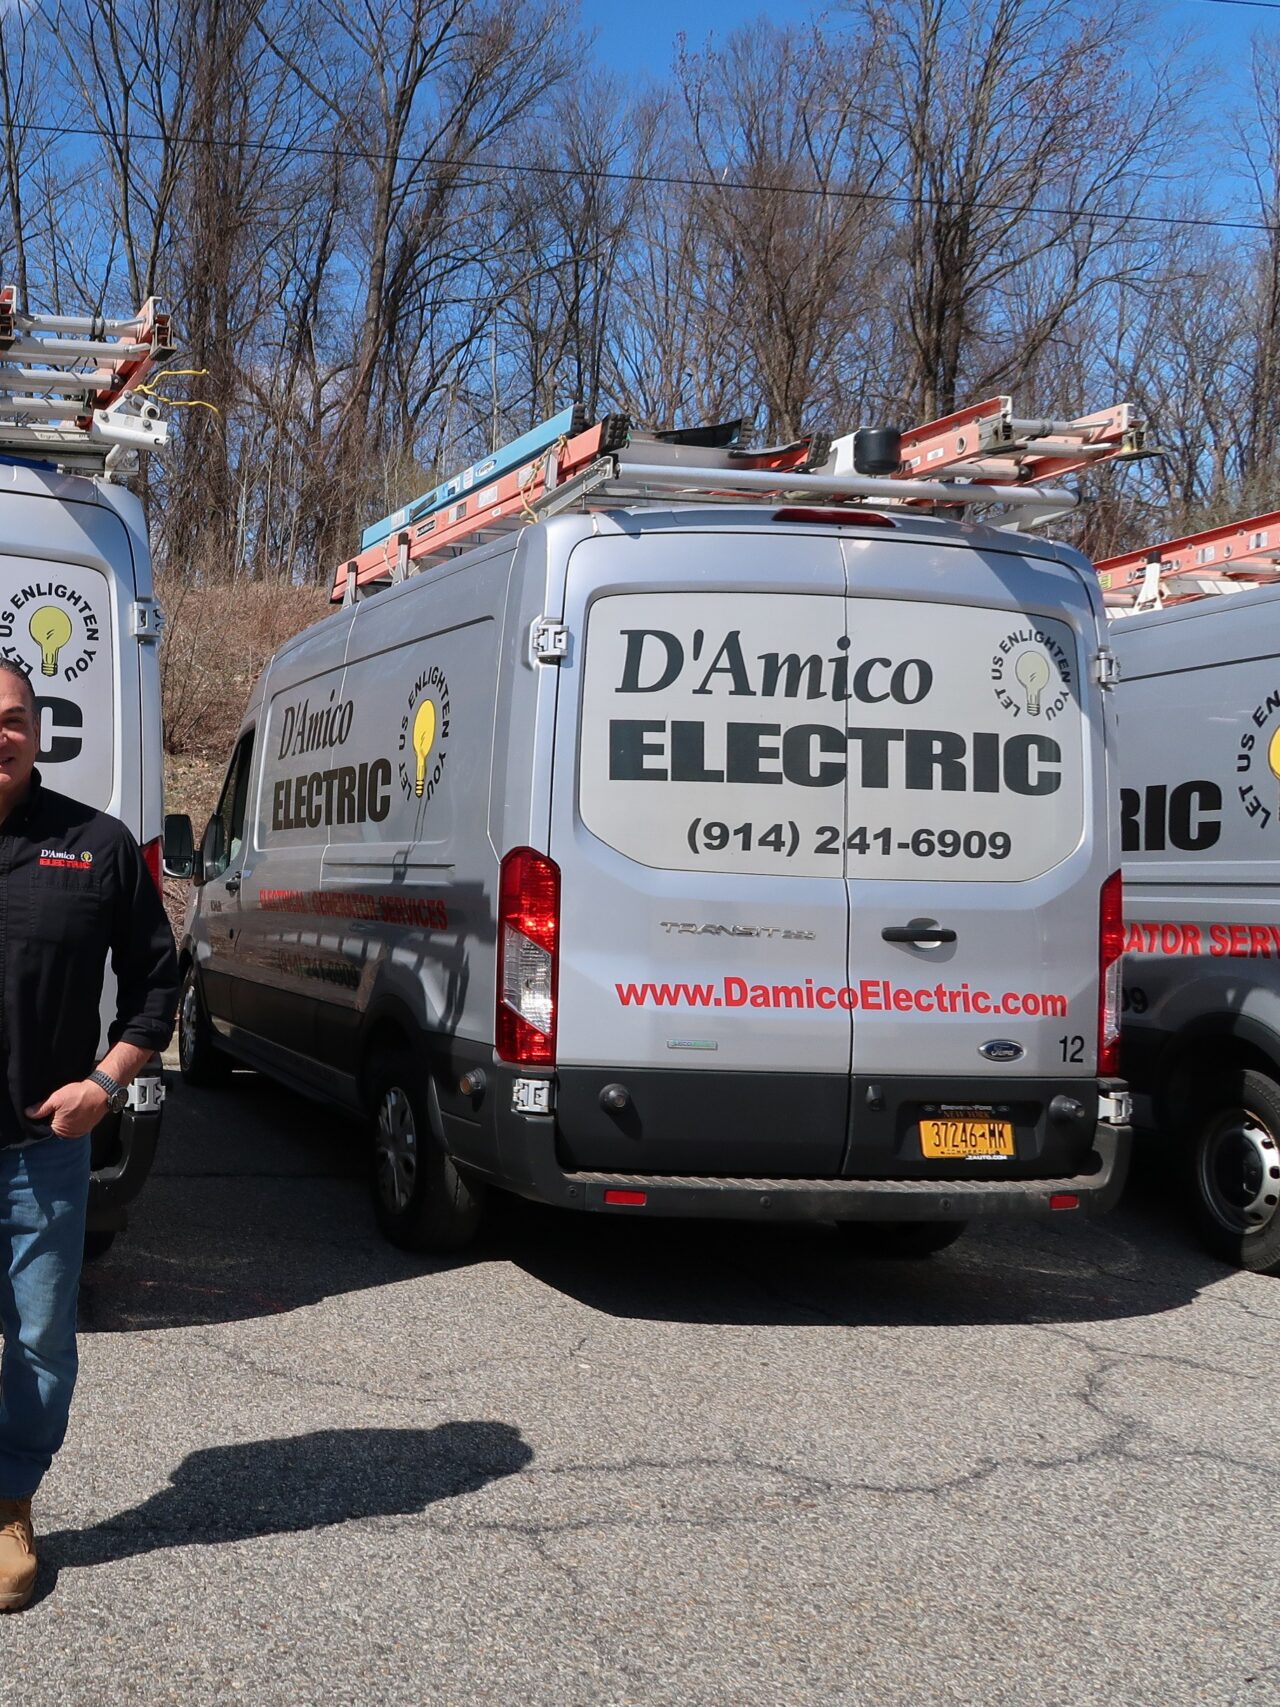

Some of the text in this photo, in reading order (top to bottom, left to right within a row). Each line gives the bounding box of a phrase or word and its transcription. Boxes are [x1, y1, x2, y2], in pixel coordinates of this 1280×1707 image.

[0, 582, 99, 682] LET US ENLIGHTEN YOU
[614, 629, 933, 705] D'Amico
[991, 629, 1071, 721] LET US ENLIGHTEN YOU
[277, 689, 354, 760] D'Amico
[399, 666, 451, 801] LET US ENLIGHTEN YOU
[609, 720, 1062, 796] ELECTRIC
[1236, 733, 1255, 772] US
[272, 758, 392, 831] ELECTRIC
[1238, 785, 1271, 829] LET
[41, 849, 75, 860] D'Amico
[687, 818, 1011, 860] (914) 241-6909
[39, 858, 92, 869] ELECTRIC
[660, 922, 780, 937] TRANSIT
[615, 976, 1068, 1017] www.DamicoElectric.com
[991, 1046, 1015, 1056] Ford
[1059, 1035, 1085, 1063] 12
[932, 1122, 977, 1148] 37246
